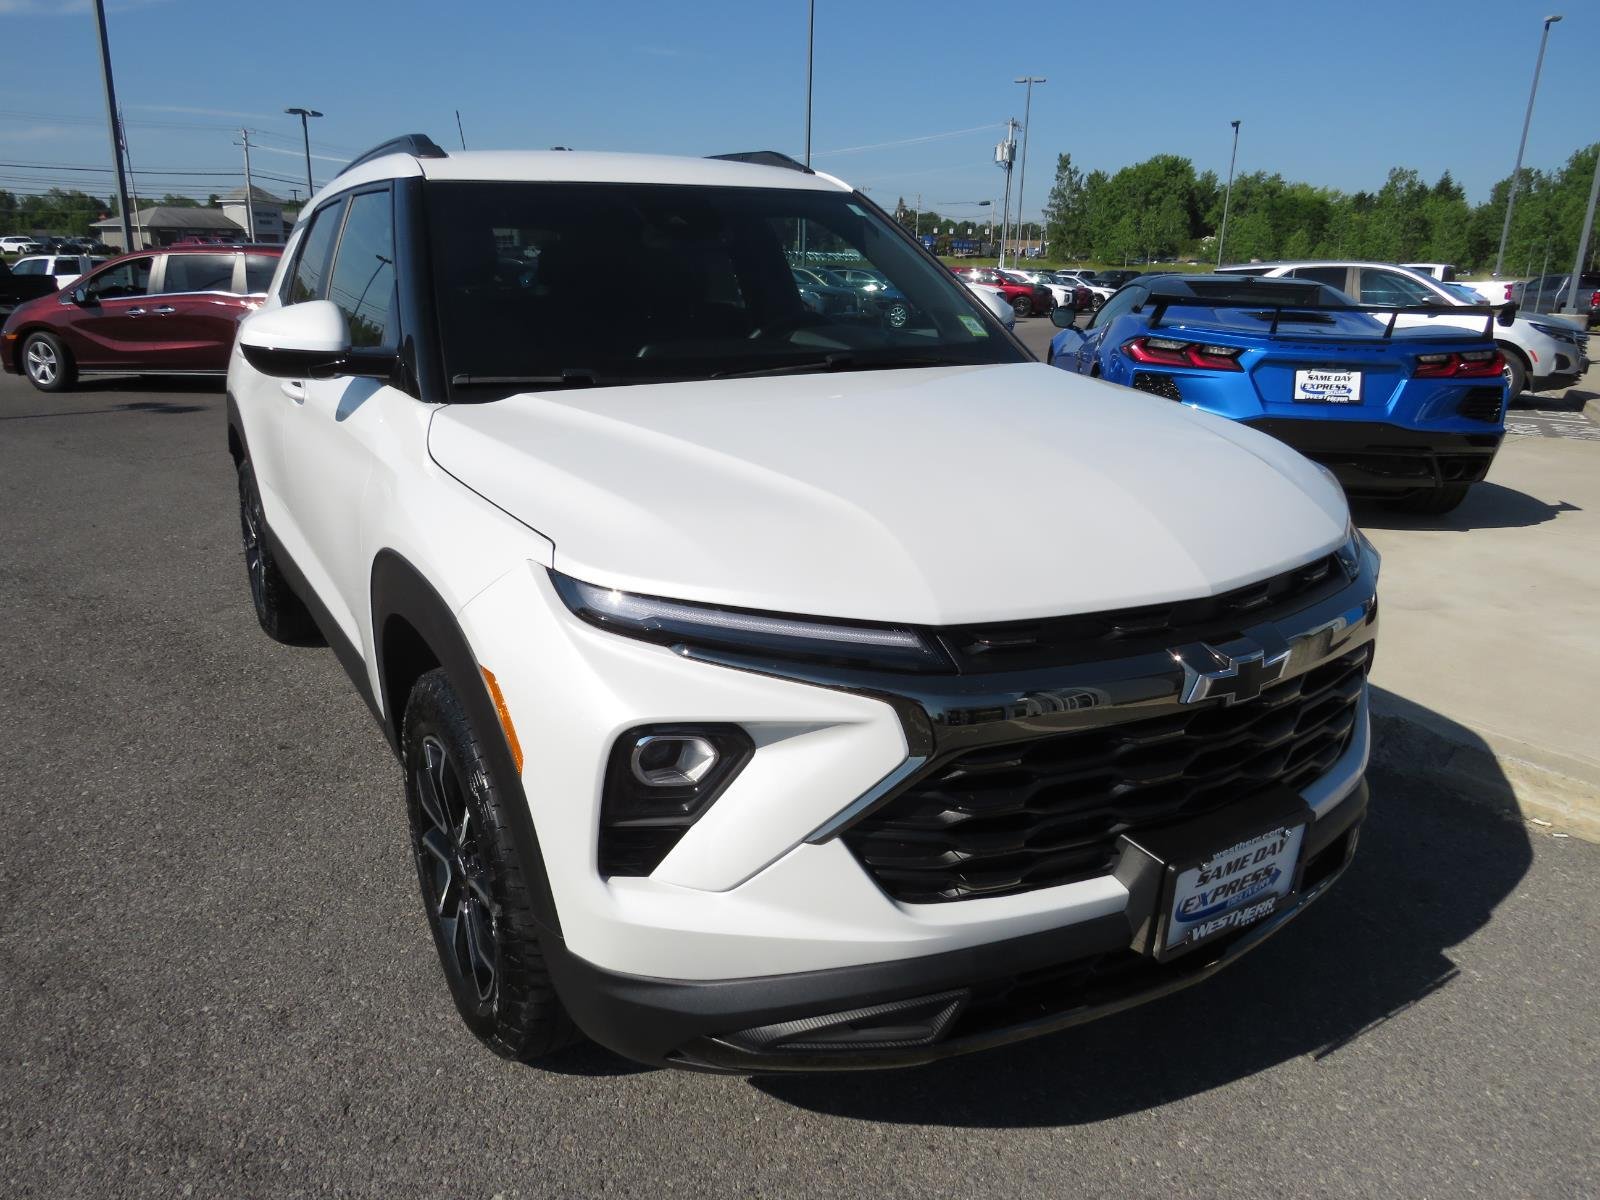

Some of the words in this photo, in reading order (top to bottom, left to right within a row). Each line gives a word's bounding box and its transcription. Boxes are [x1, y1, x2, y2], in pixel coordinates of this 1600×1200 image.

[1302, 383, 1348, 391] EXPRESS
[1307, 374, 1333, 382] SAME
[1195, 853, 1253, 888] SAME
[1252, 837, 1290, 865] DAY
[1181, 862, 1276, 914] EXPRESS
